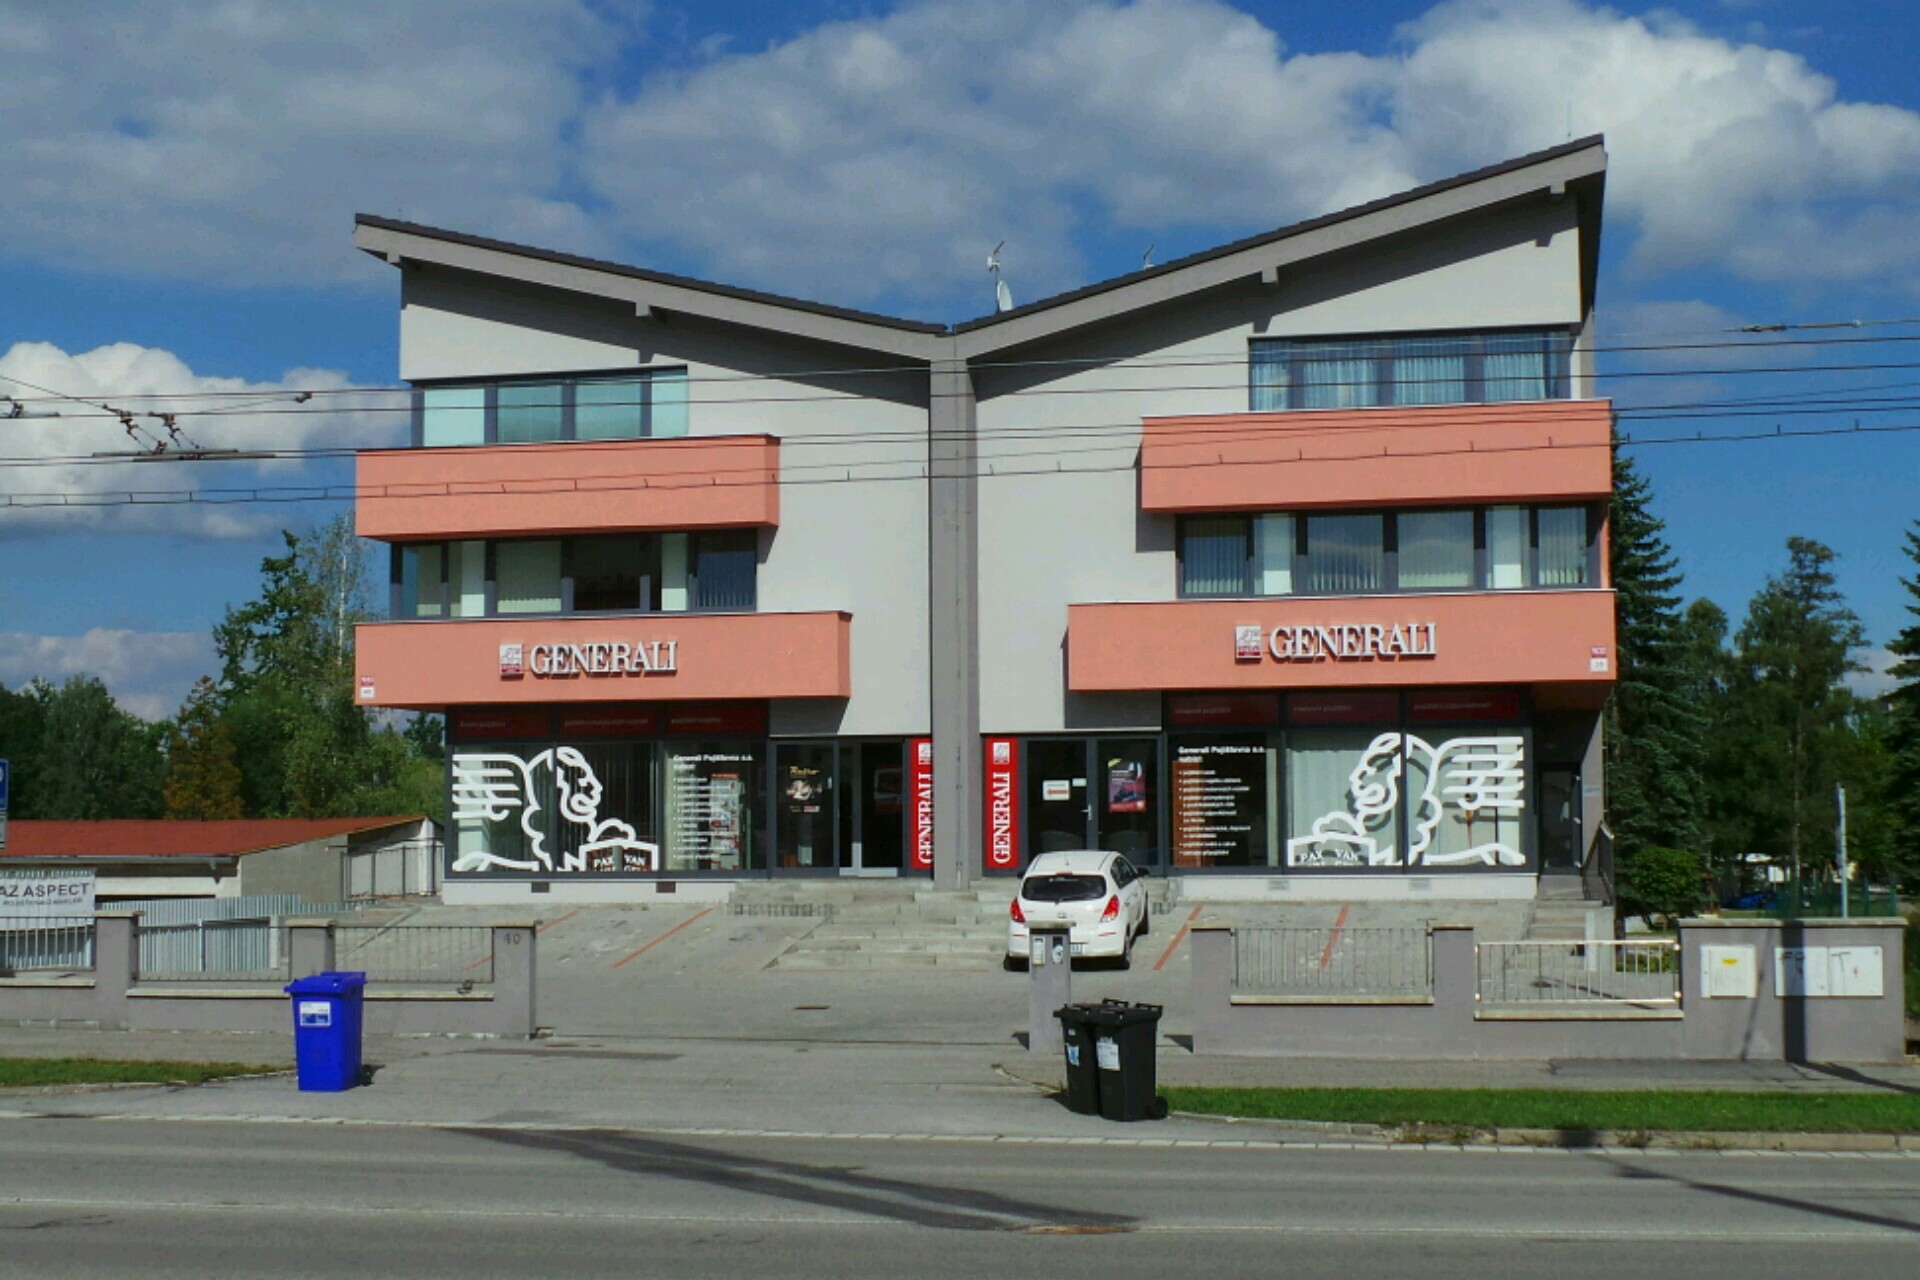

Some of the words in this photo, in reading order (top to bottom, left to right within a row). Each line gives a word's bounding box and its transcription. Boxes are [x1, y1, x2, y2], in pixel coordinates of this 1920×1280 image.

[530, 640, 678, 675] GENERALI
[1269, 622, 1437, 659] GENERALI
[917, 771, 933, 864] GENERALI
[993, 771, 1011, 864] GENERALI
[23, 882, 90, 898] ASPECT
